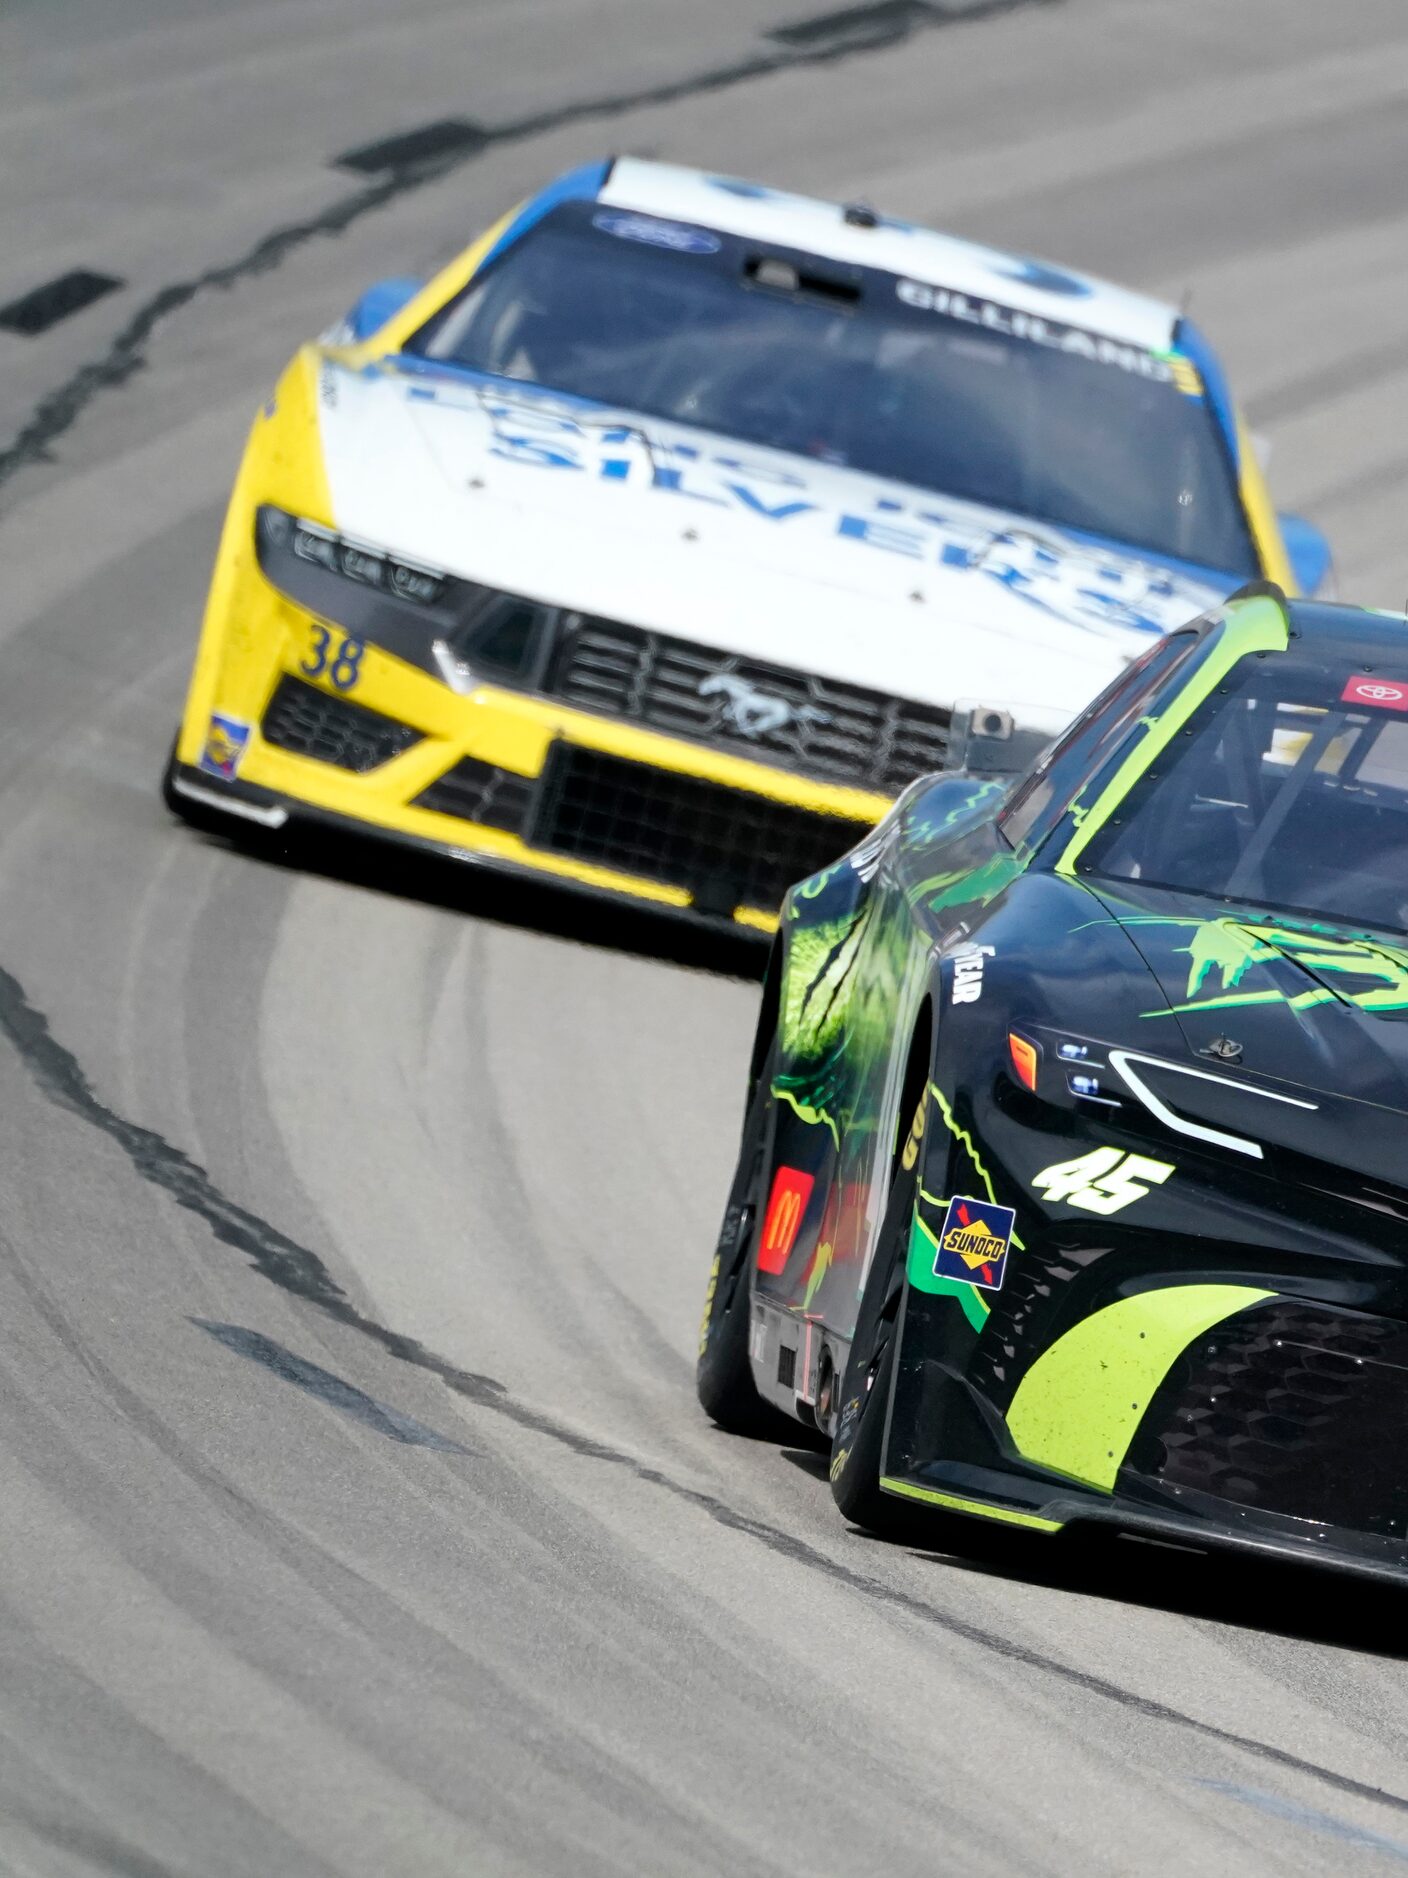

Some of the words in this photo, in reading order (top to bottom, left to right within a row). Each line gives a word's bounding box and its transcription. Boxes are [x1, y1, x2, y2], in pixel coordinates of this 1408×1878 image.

[896, 278, 1172, 383] GILLILAND
[301, 624, 366, 692] 38
[1031, 1146, 1177, 1216] 45
[946, 1230, 1003, 1260] SUNOCO
